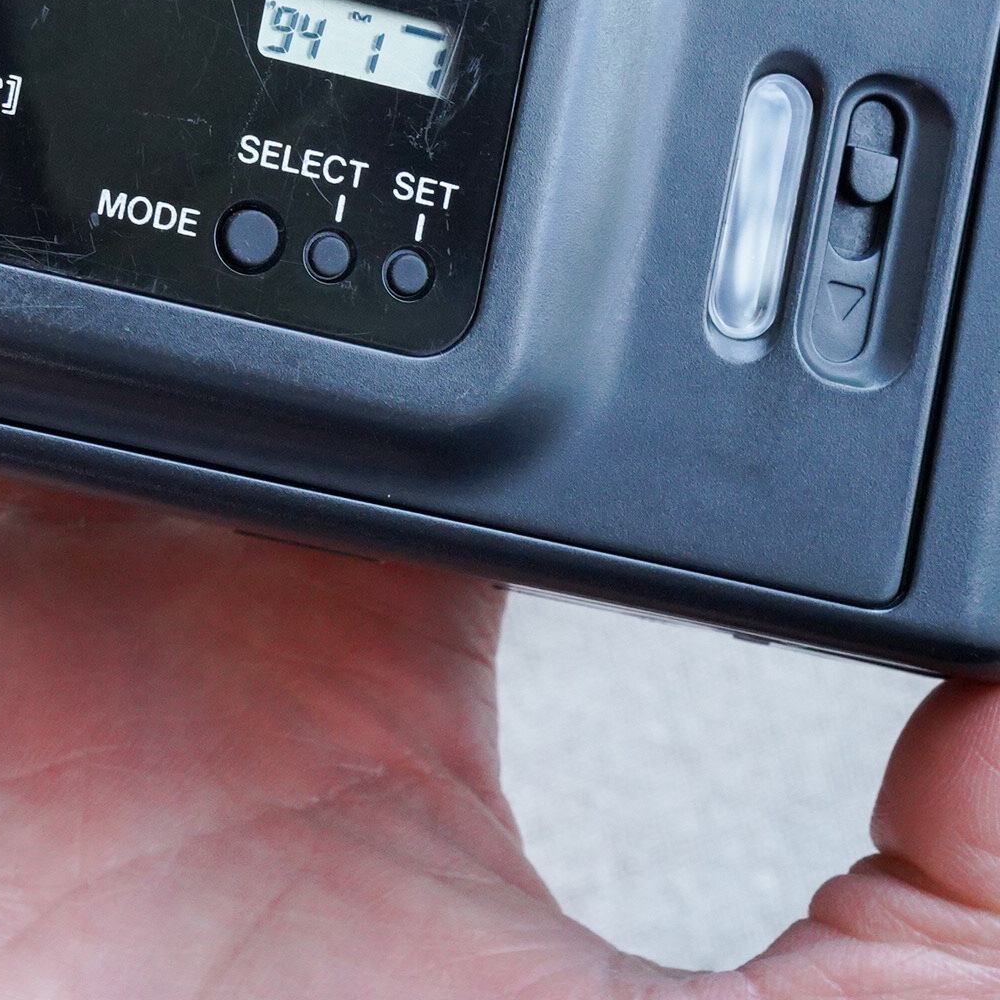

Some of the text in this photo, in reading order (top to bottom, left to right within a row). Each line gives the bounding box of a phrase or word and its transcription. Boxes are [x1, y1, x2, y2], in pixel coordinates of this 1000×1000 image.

[237, 134, 370, 189] SELECT
[97, 188, 201, 238] MODE
[392, 171, 460, 210] SET
